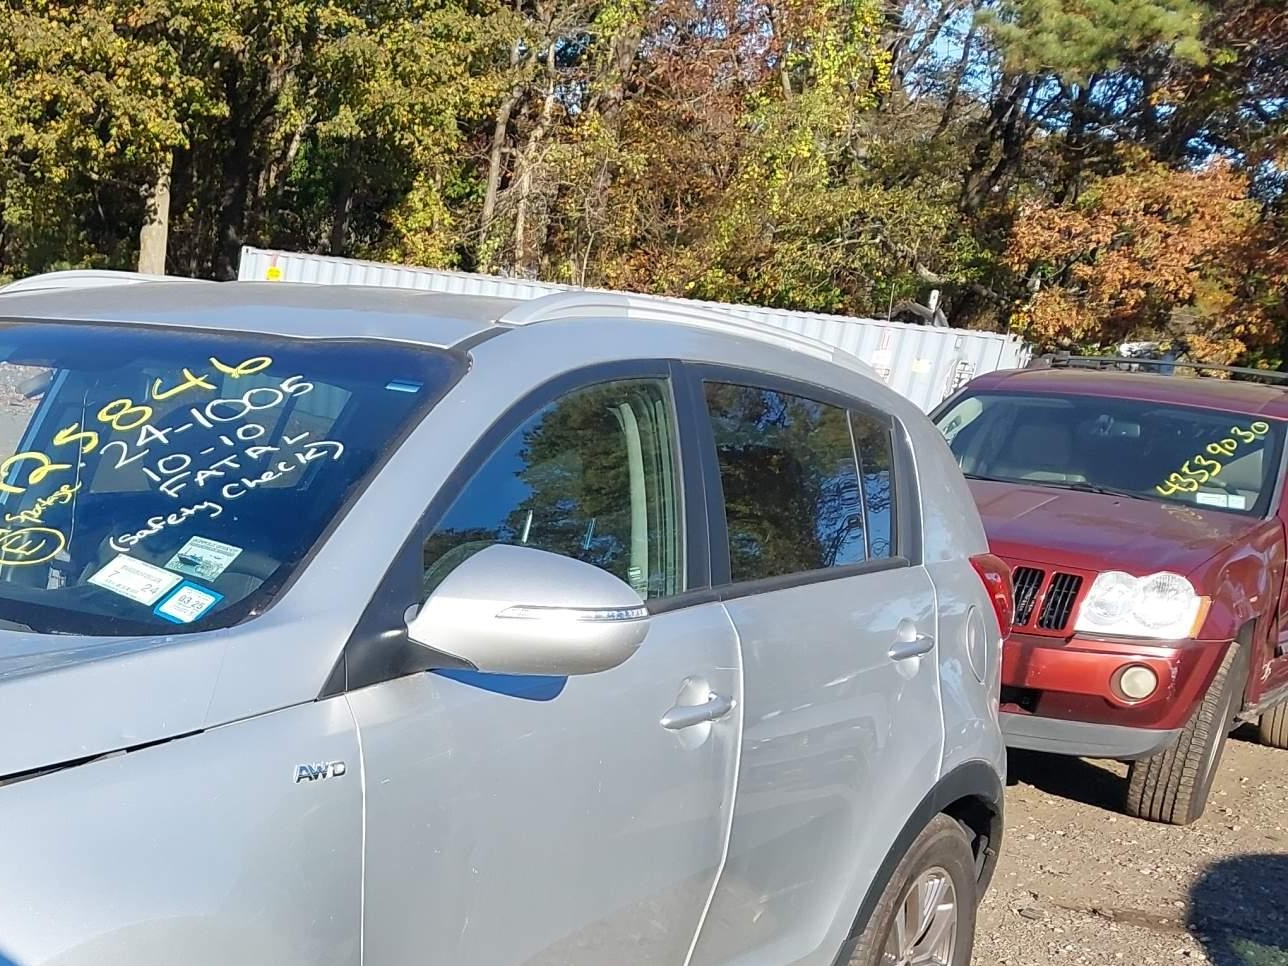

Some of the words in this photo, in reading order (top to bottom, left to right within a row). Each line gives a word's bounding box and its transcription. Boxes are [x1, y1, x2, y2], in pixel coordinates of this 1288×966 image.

[100, 375, 313, 469] 24-1005
[142, 423, 265, 482] 10-10
[159, 431, 310, 498] FATAL
[1156, 421, 1269, 495] 43539030
[293, 760, 346, 784] AWD
